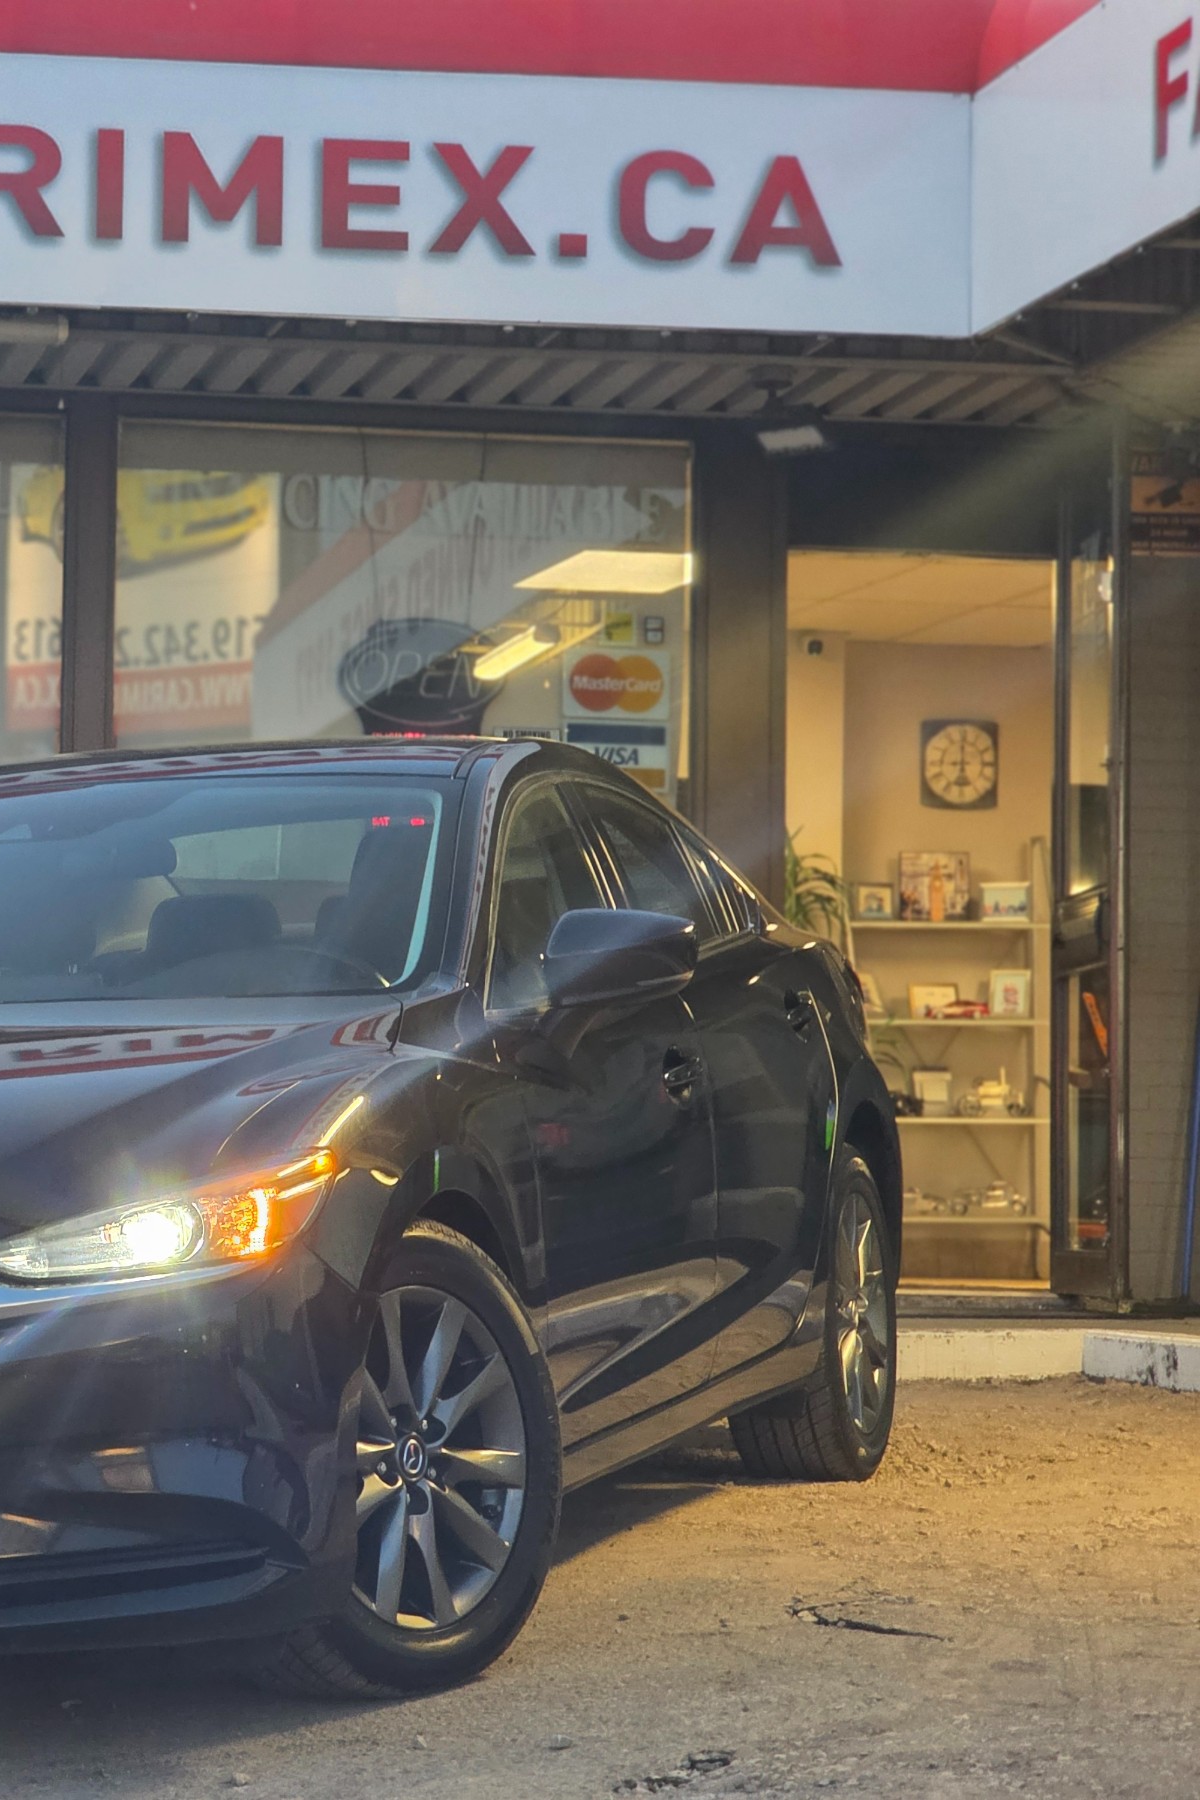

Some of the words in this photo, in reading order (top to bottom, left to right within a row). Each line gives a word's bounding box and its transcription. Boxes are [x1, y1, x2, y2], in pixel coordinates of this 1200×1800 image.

[353, 648, 481, 700] OPEN
[572, 674, 663, 694] MasterCard
[594, 746, 640, 766] VISA
